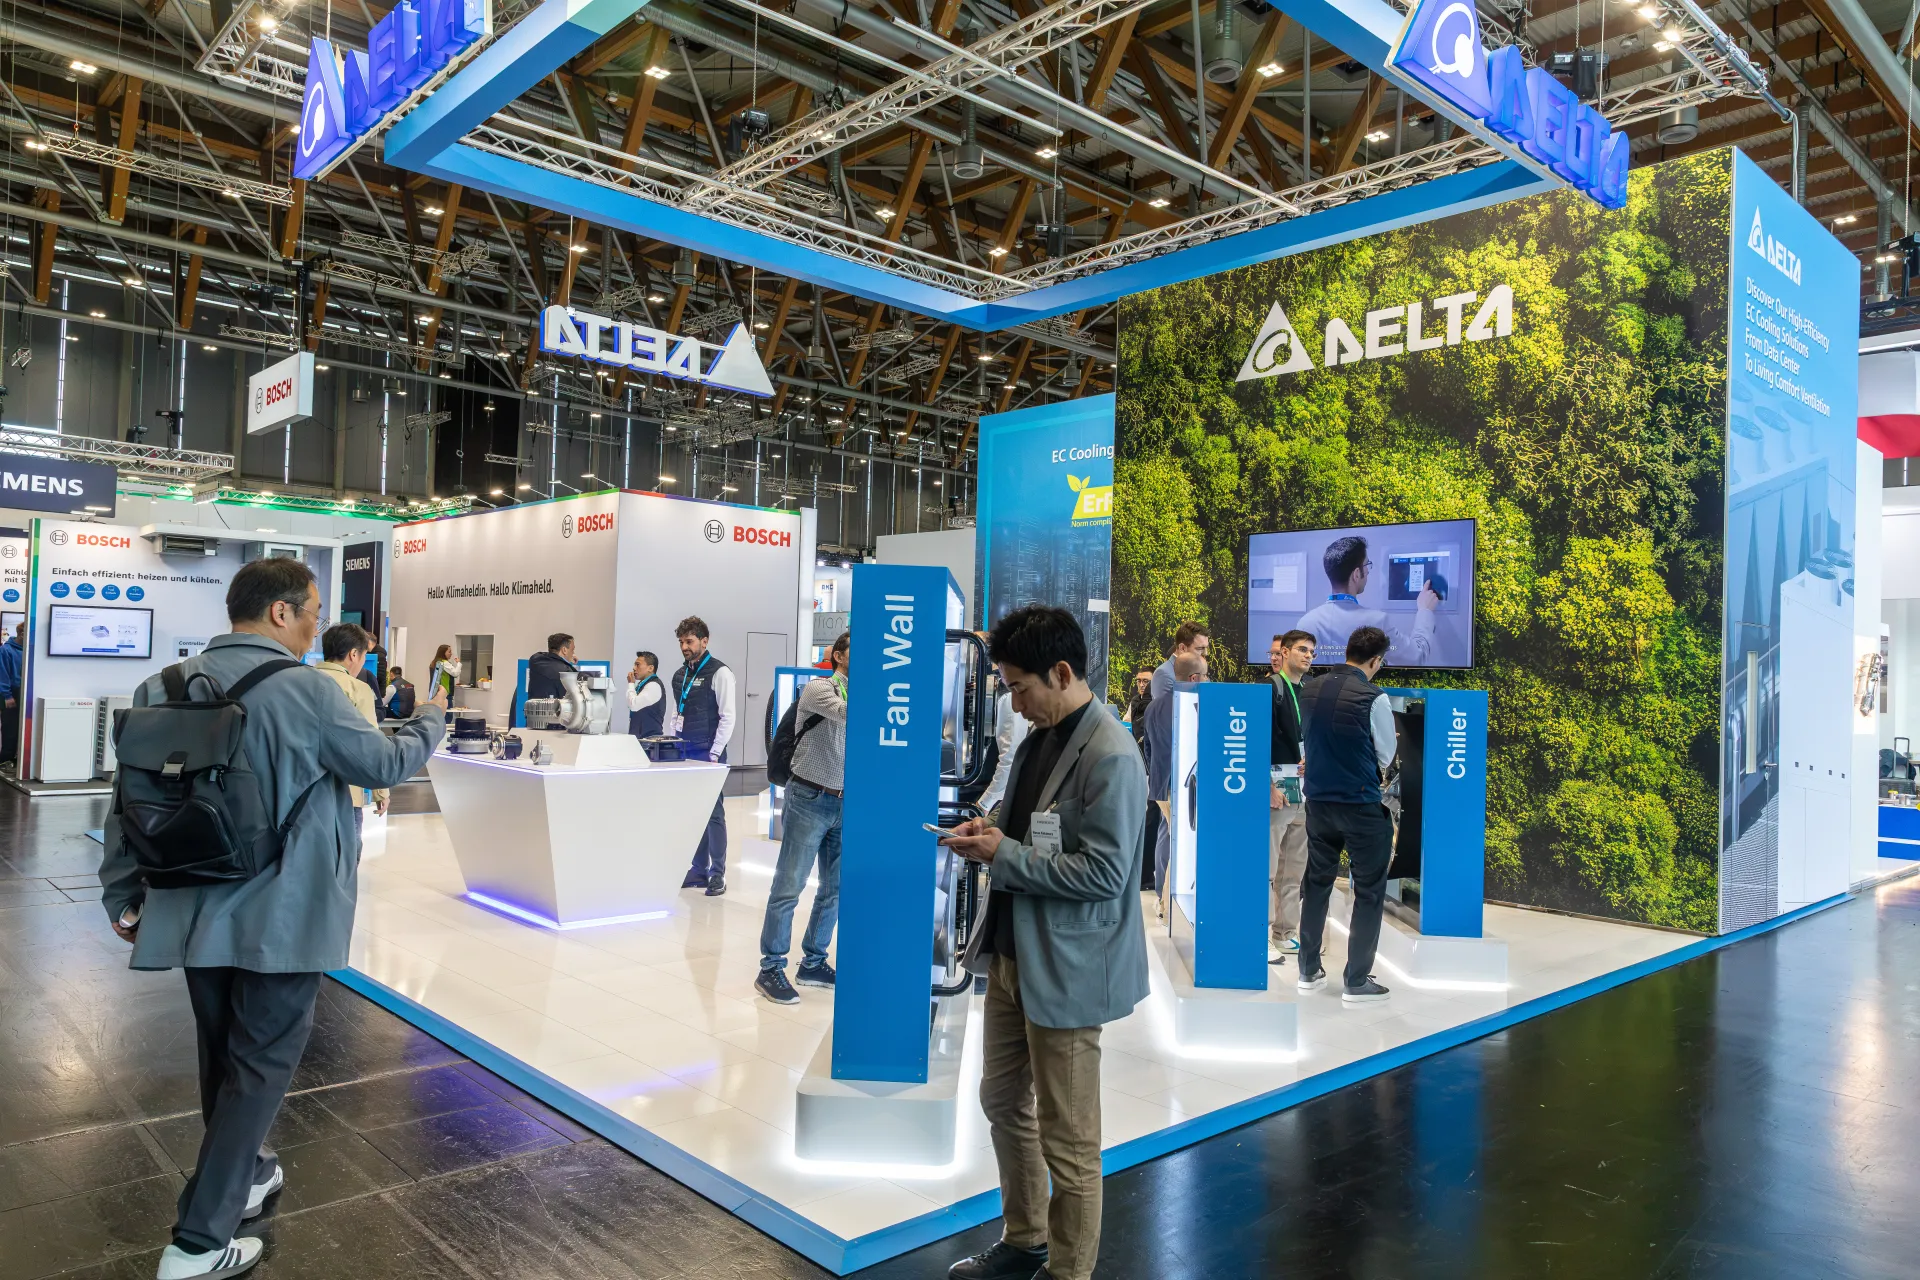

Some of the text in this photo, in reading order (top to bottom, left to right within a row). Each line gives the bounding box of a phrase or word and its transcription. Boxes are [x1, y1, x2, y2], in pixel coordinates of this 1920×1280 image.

[1487, 45, 1630, 210] DELTA
[1767, 234, 1802, 287] DELTA
[1324, 284, 1514, 367] DELTA
[1746, 276, 1830, 354] Discover Our High-Efficiency
[1745, 302, 1809, 359] EC Cooling Solutions
[1745, 327, 1801, 376] From Data Center
[266, 377, 292, 406] BOSCH
[1744, 352, 1831, 418] To Living Comfort Ventilation
[1052, 443, 1114, 464] EC Cooling
[0, 471, 84, 496] MENS
[577, 512, 614, 533] BOSCH
[733, 525, 792, 548] BOSCH
[1071, 520, 1088, 528] Norm
[76, 533, 131, 549] BOSCH
[403, 538, 427, 555] BOSCH
[52, 567, 223, 585] Einfach effizient: heizen und kühlen.
[345, 556, 371, 572] SIEMENS
[427, 578, 554, 600] Hallo Klimaheldin. Hallo Klimaheld.
[879, 594, 915, 747] Fan Wall
[1223, 705, 1247, 794] Chiller
[1446, 707, 1467, 779] Chiller
